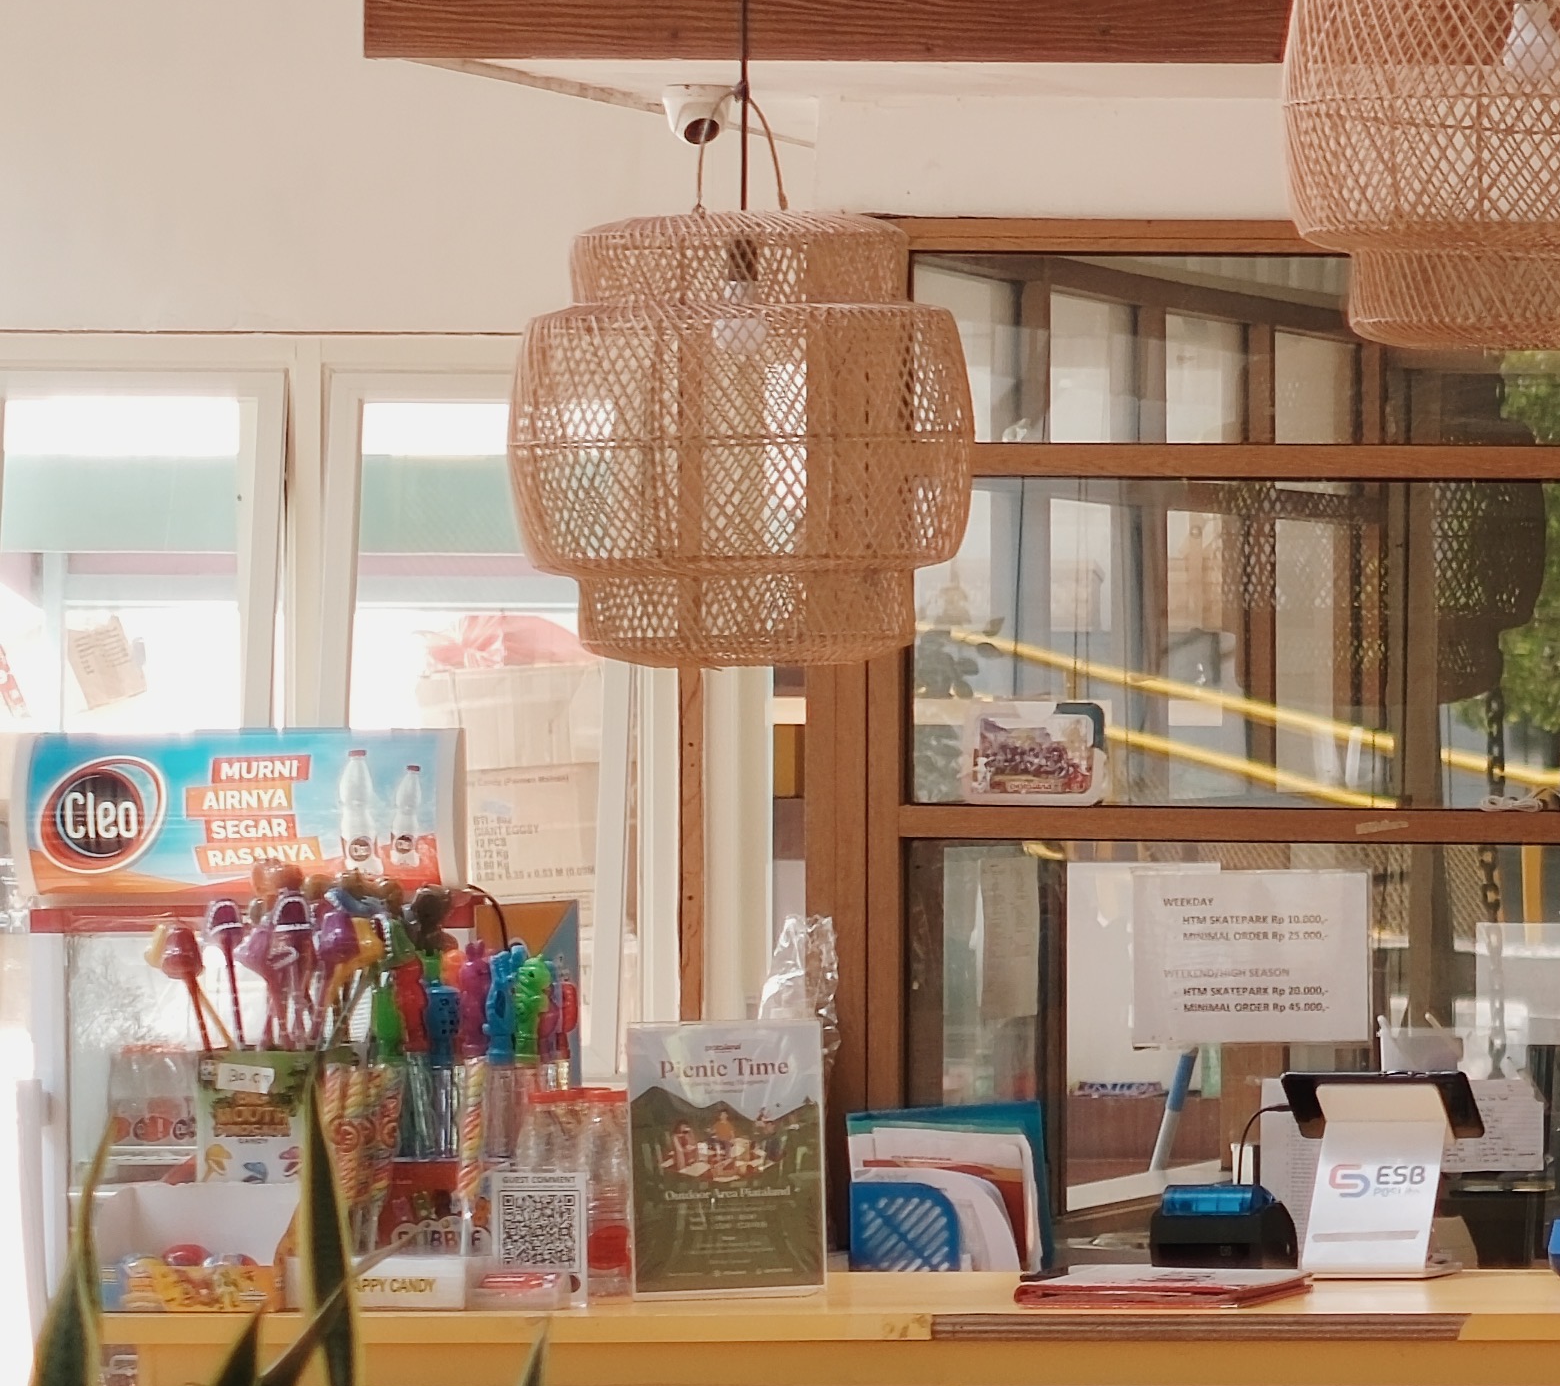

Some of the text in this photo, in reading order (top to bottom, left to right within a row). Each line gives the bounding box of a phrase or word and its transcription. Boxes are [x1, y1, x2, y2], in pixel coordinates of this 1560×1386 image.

[219, 759, 299, 780] MURNI
[201, 787, 288, 812] AIRNYA
[64, 790, 139, 840] Cleo
[210, 818, 288, 840] SEGAR
[206, 843, 317, 868] RASANYA
[1163, 897, 1214, 907] WEEKDAY
[1182, 915, 1207, 925] HTM
[1210, 915, 1269, 925] SKATEPARK
[1271, 915, 1285, 926] Rp
[1183, 932, 1230, 941] MINIMAL
[1233, 931, 1270, 941] ORDER
[1271, 931, 1285, 942] Rp
[1248, 968, 1290, 978] SEASON
[1183, 987, 1208, 997] HTM
[1210, 987, 1269, 997] SKATEPARK
[1272, 987, 1286, 997] Rp
[1183, 1003, 1231, 1012] MINIMAL
[1234, 1003, 1270, 1012] ORDER
[1272, 1003, 1286, 1014] Rp
[660, 1057, 789, 1079] Picnic Time
[1375, 1165, 1426, 1186] ESB
[665, 1189, 711, 1201] Outdoor
[353, 1277, 437, 1294] APPY CANDY
